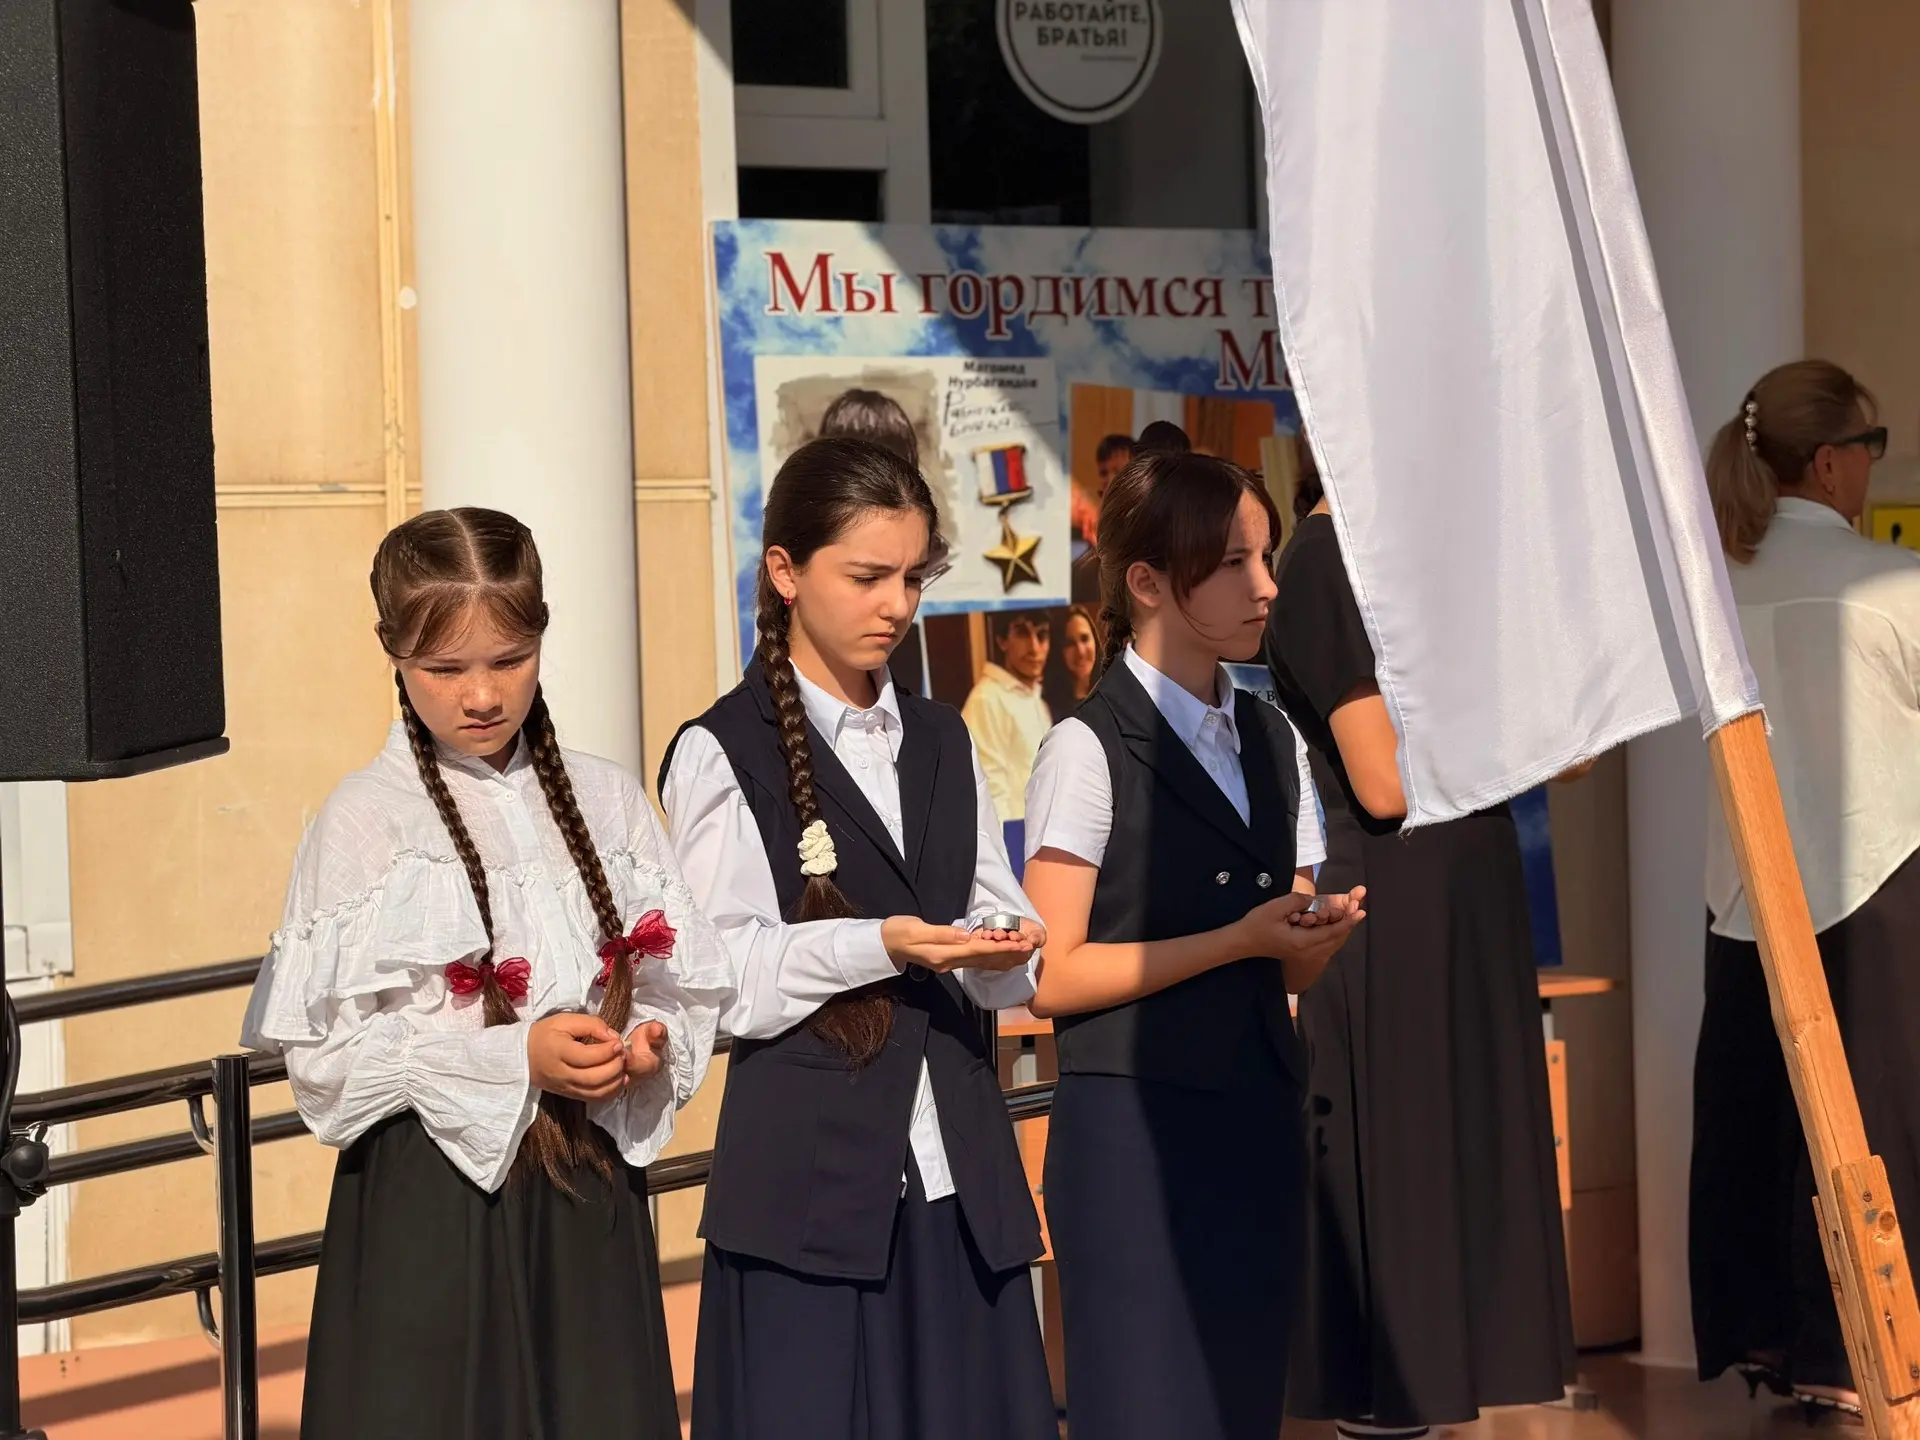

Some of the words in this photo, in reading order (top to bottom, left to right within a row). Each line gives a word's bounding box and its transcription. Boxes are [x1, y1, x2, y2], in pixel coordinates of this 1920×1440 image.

[1036, 26, 1127, 47] БРАТЬЯ!
[764, 251, 898, 314] Мы
[916, 274, 1227, 336] гордимся
